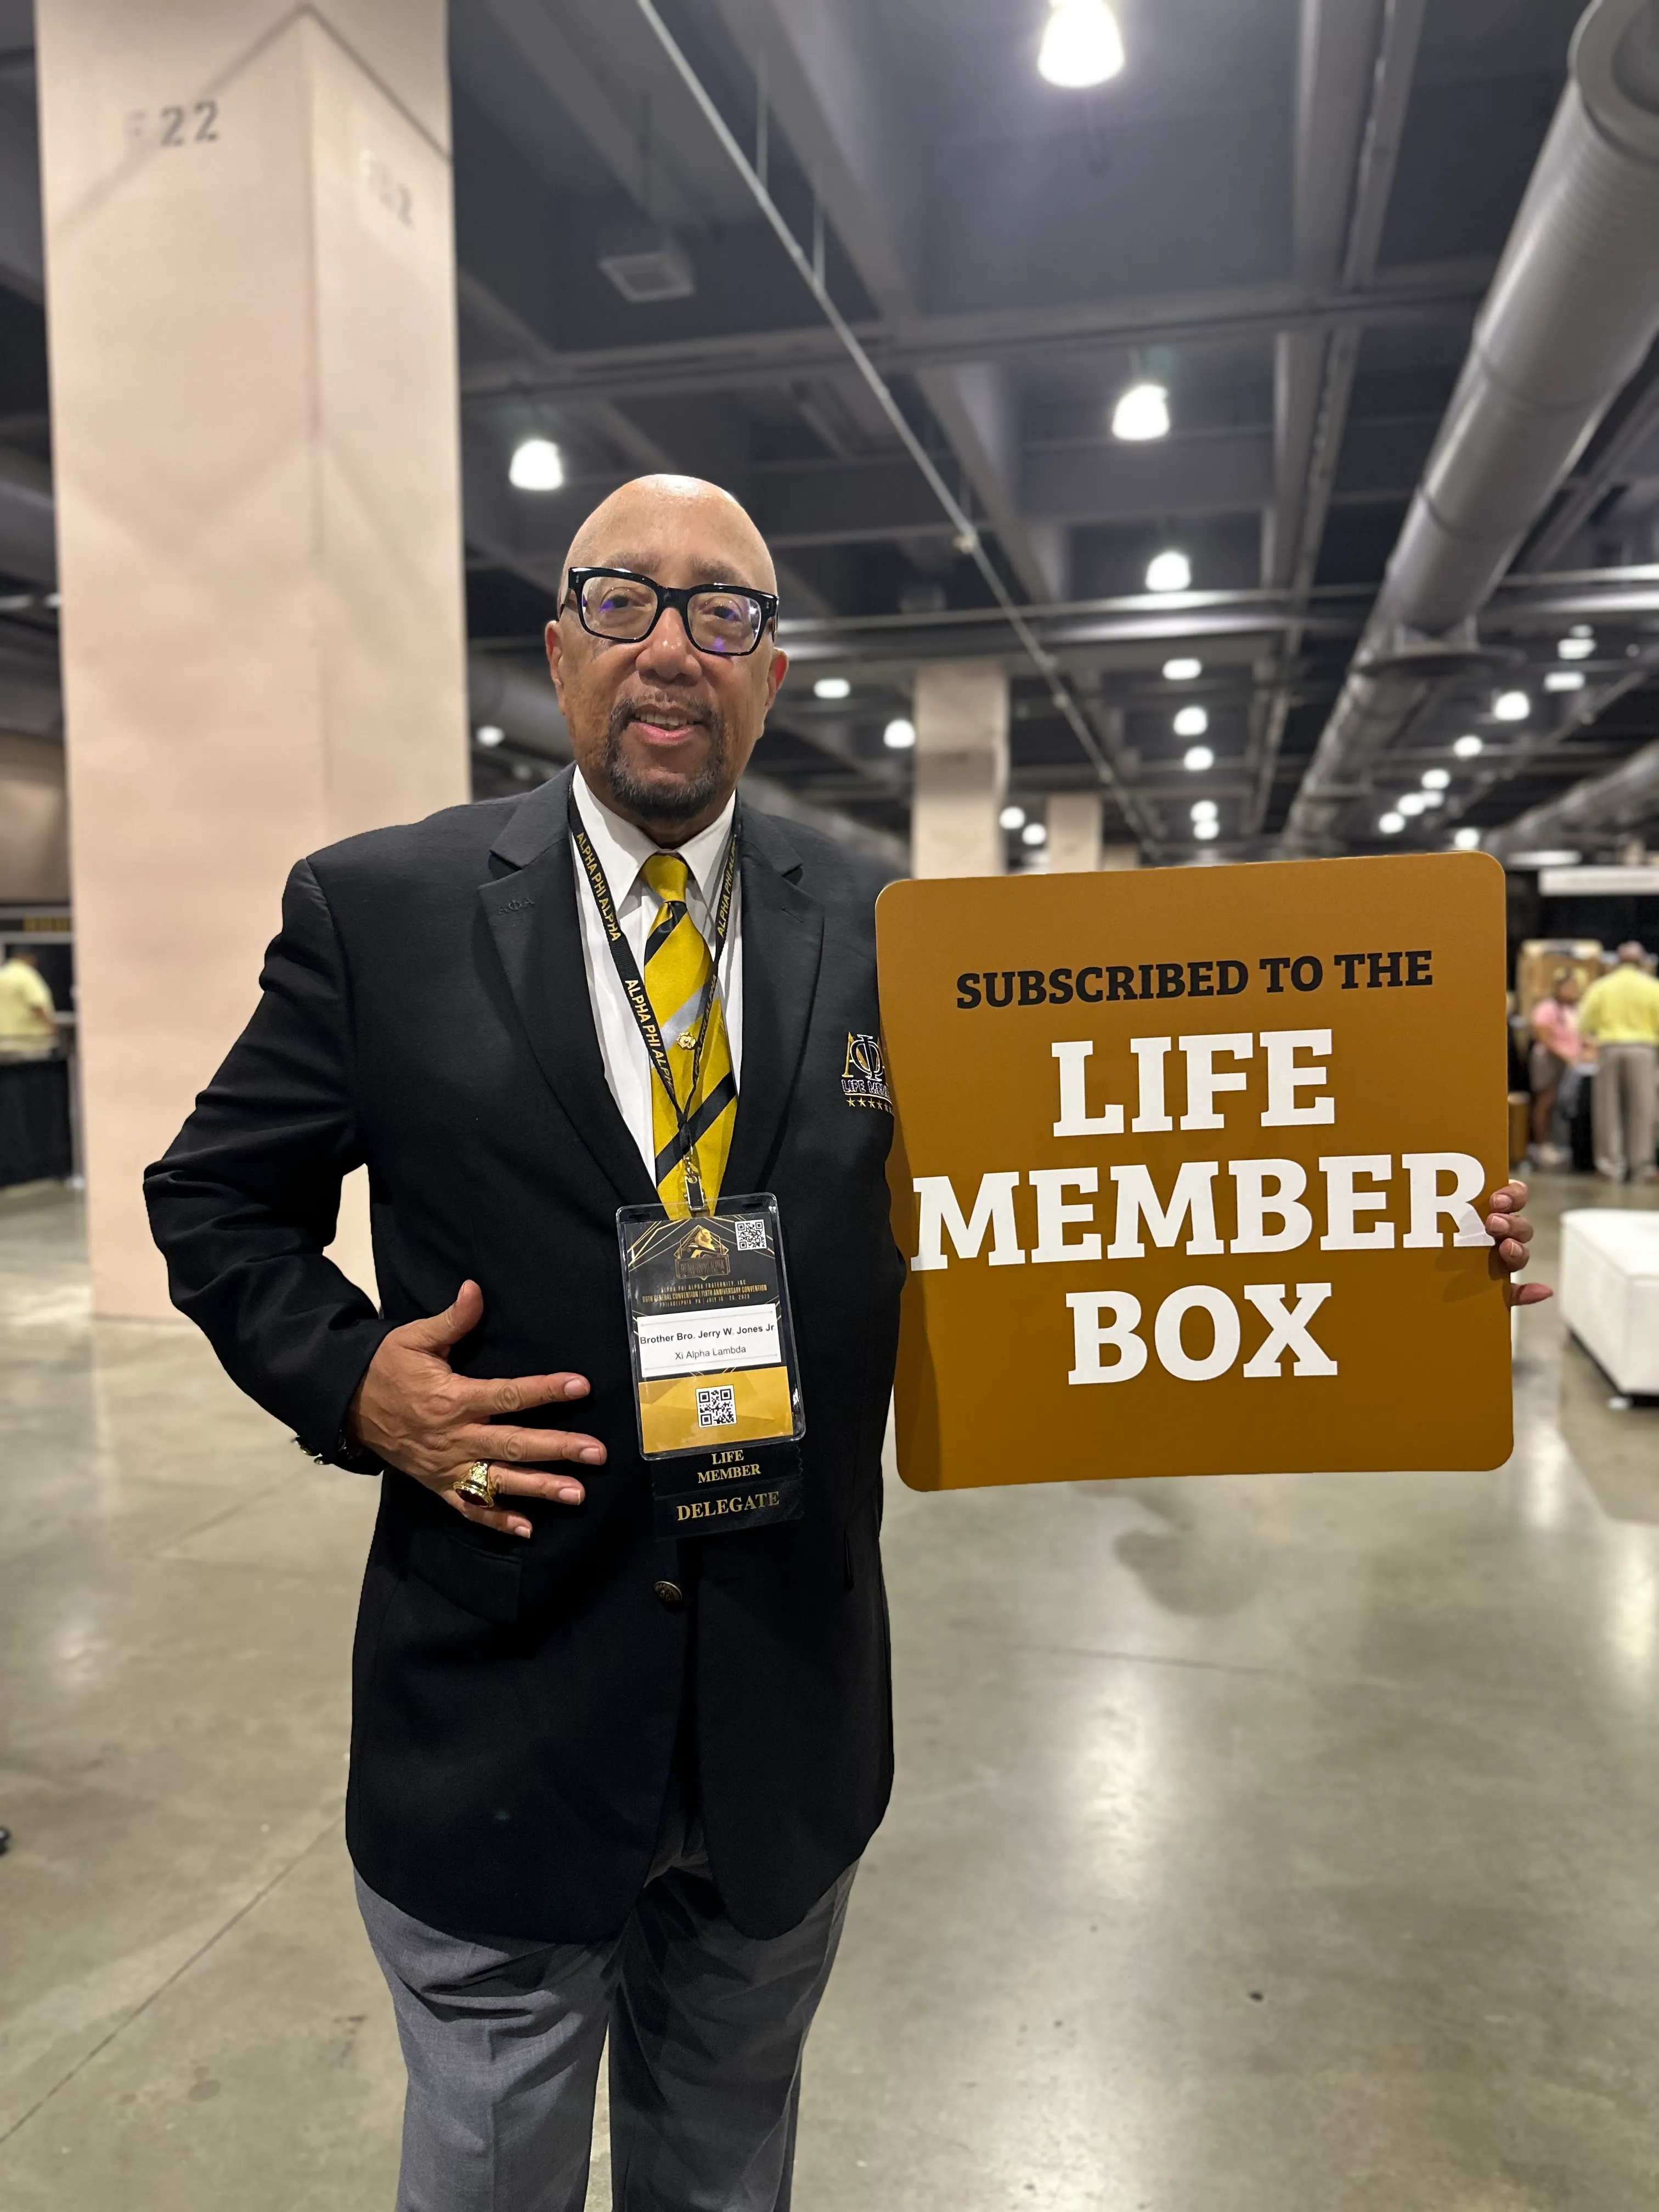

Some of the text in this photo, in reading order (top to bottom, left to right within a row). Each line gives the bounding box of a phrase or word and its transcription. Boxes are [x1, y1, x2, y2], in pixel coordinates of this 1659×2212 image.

[577, 832, 622, 941] ALPHA PHI ALPHA
[718, 894, 730, 939] ALPHA
[725, 870, 733, 894] PHI
[957, 950, 1433, 1009] SUBSCRIBED TO THE
[625, 980, 652, 1023] ALPHA
[642, 1024, 661, 1047] PHI
[841, 1079, 866, 1093] LIFE
[1051, 1029, 1335, 1137] LIFE
[911, 1152, 1496, 1271] MEMBER
[653, 1293, 672, 1302] GENERAL
[673, 1290, 698, 1300] CONVENTION
[713, 1286, 741, 1295] ANNIVERSARY
[742, 1284, 768, 1293] CONVENTION
[640, 1334, 674, 1345] Brother
[676, 1333, 696, 1341] Bro.
[698, 1330, 721, 1339] Jerry
[723, 1327, 735, 1335] W.
[737, 1326, 763, 1334] Jones
[675, 1345, 746, 1360] Xi Alpha Lambda
[1065, 1283, 1339, 1385] BOX
[697, 1463, 761, 1483] MEMBER
[712, 1449, 744, 1465] LIFE
[676, 1491, 780, 1521] DELEGATE
